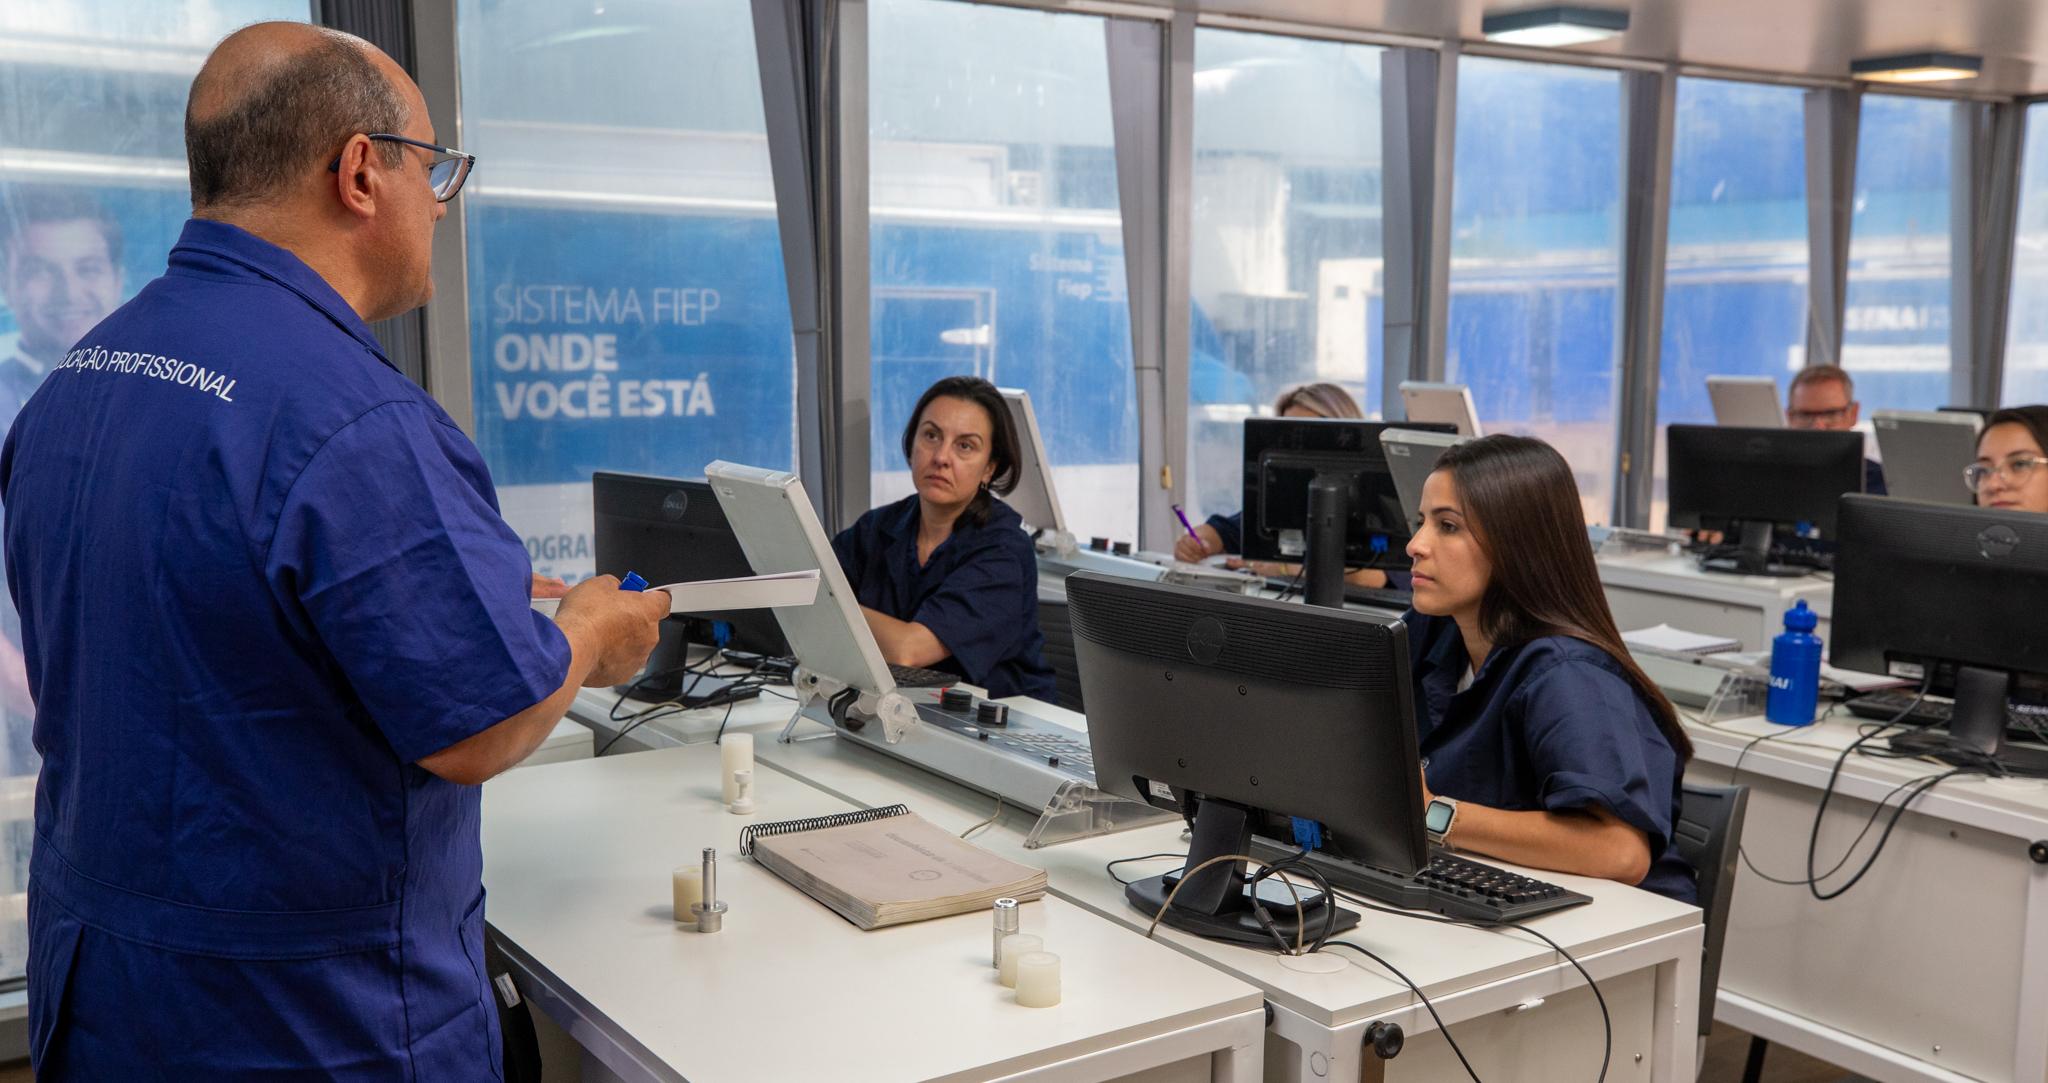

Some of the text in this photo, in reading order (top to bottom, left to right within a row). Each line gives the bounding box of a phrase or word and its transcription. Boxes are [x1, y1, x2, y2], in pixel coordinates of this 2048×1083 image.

[494, 284, 721, 326] SISTEMA FIEP
[1057, 278, 1092, 300] Fiep
[495, 333, 618, 372] ONDE
[106, 350, 237, 403] PROFISSIONAL
[496, 372, 715, 420] VOCÊ ESTÁ
